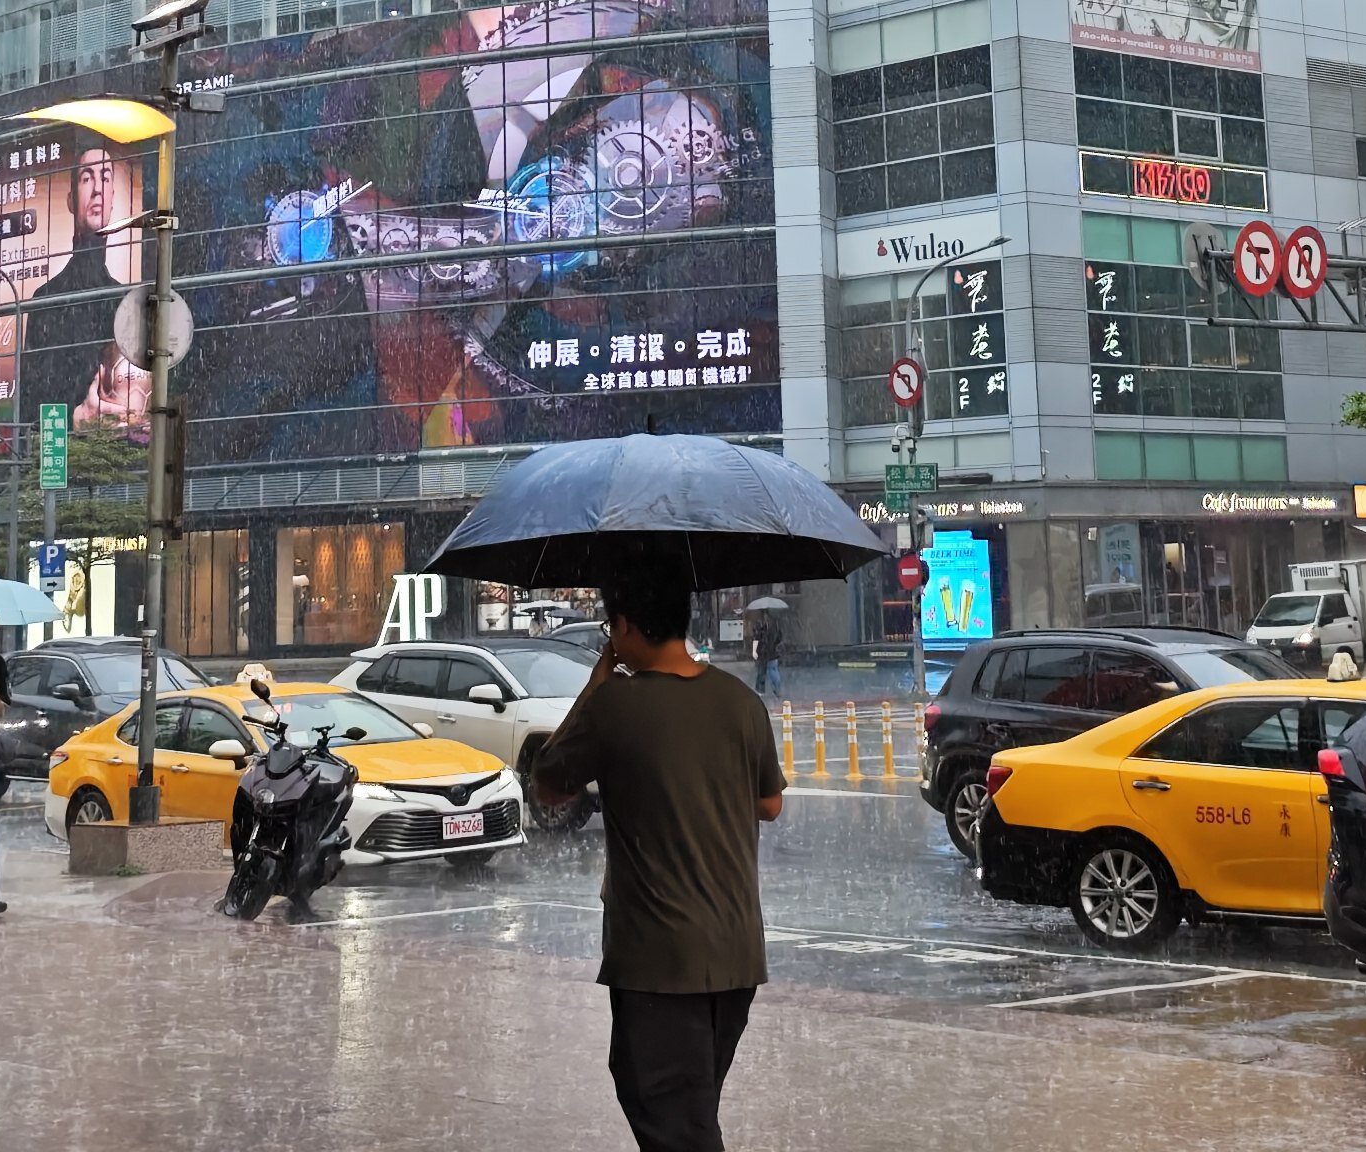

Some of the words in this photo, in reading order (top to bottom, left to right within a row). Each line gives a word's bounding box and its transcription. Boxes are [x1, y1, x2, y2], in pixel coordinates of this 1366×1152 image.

[889, 232, 965, 265] Wulao
[46, 545, 59, 564] P
[1196, 805, 1251, 825] 558-L6
